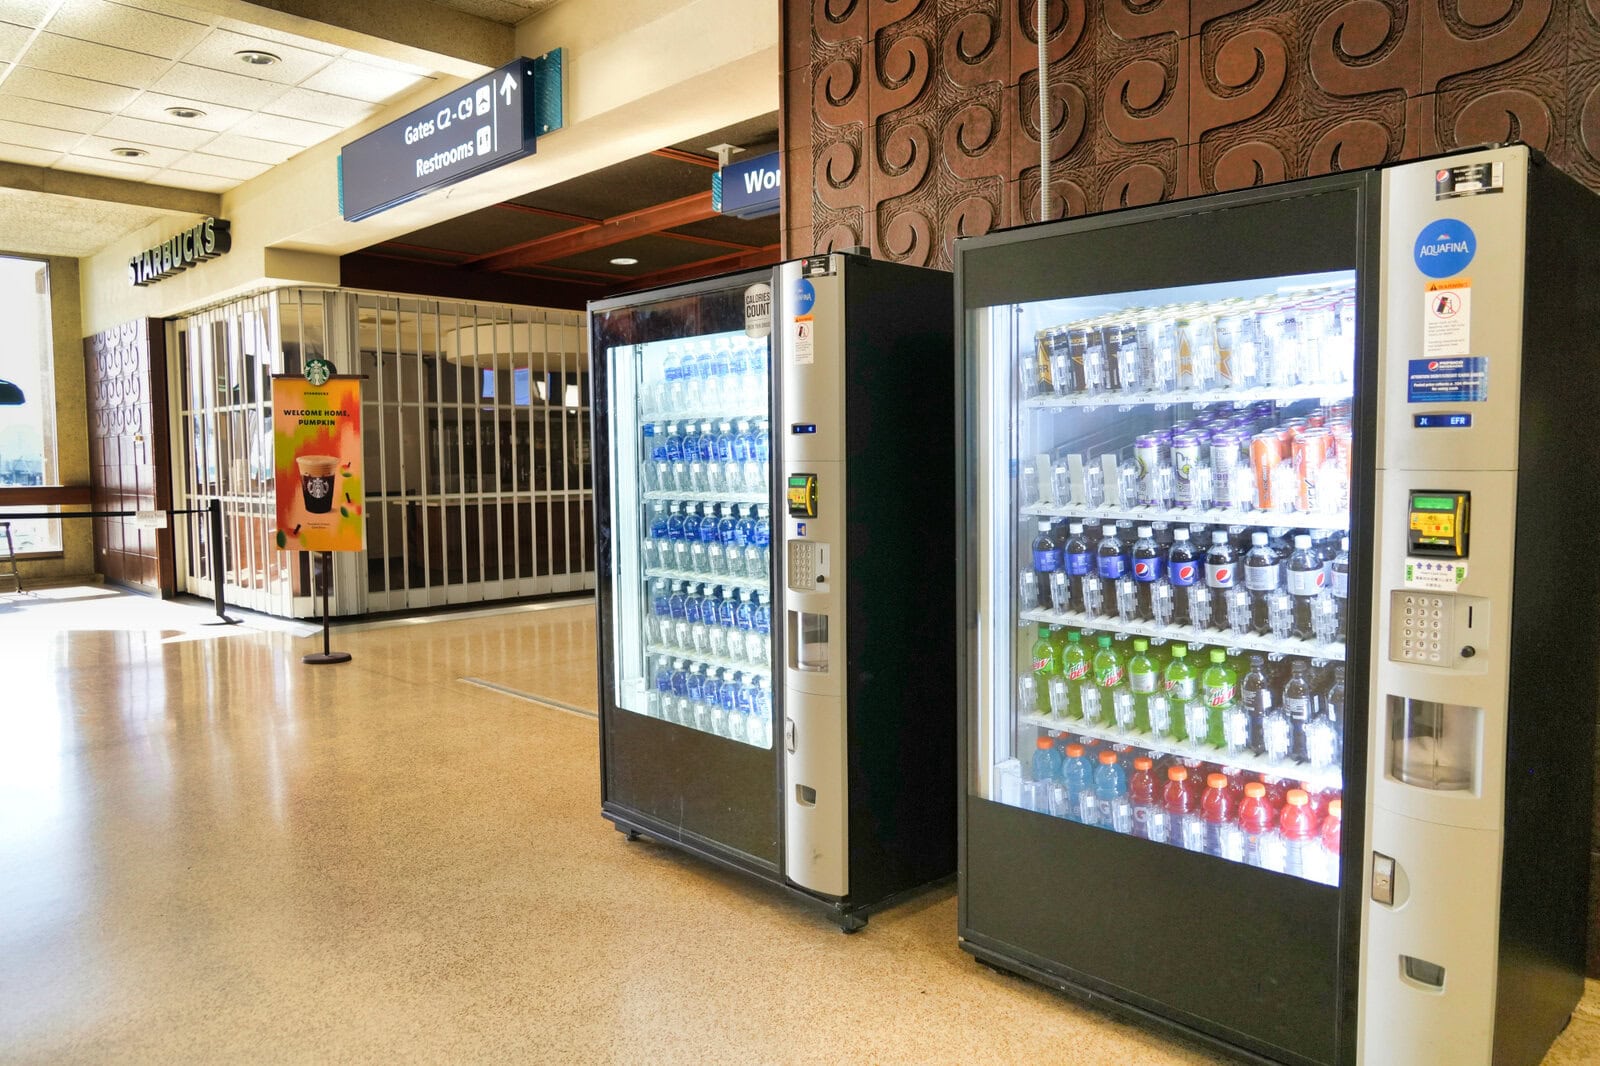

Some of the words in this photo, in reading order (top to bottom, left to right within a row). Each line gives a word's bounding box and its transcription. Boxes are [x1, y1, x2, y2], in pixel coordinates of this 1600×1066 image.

[405, 119, 434, 145] Gates
[416, 141, 474, 178] Restrooms
[128, 217, 216, 286] STARBUCKS
[1419, 240, 1469, 258] AQUAFINA
[746, 292, 770, 304] CALORIES
[747, 302, 770, 318] COUNT
[1406, 607, 1412, 615] B
[1405, 639, 1410, 647] E
